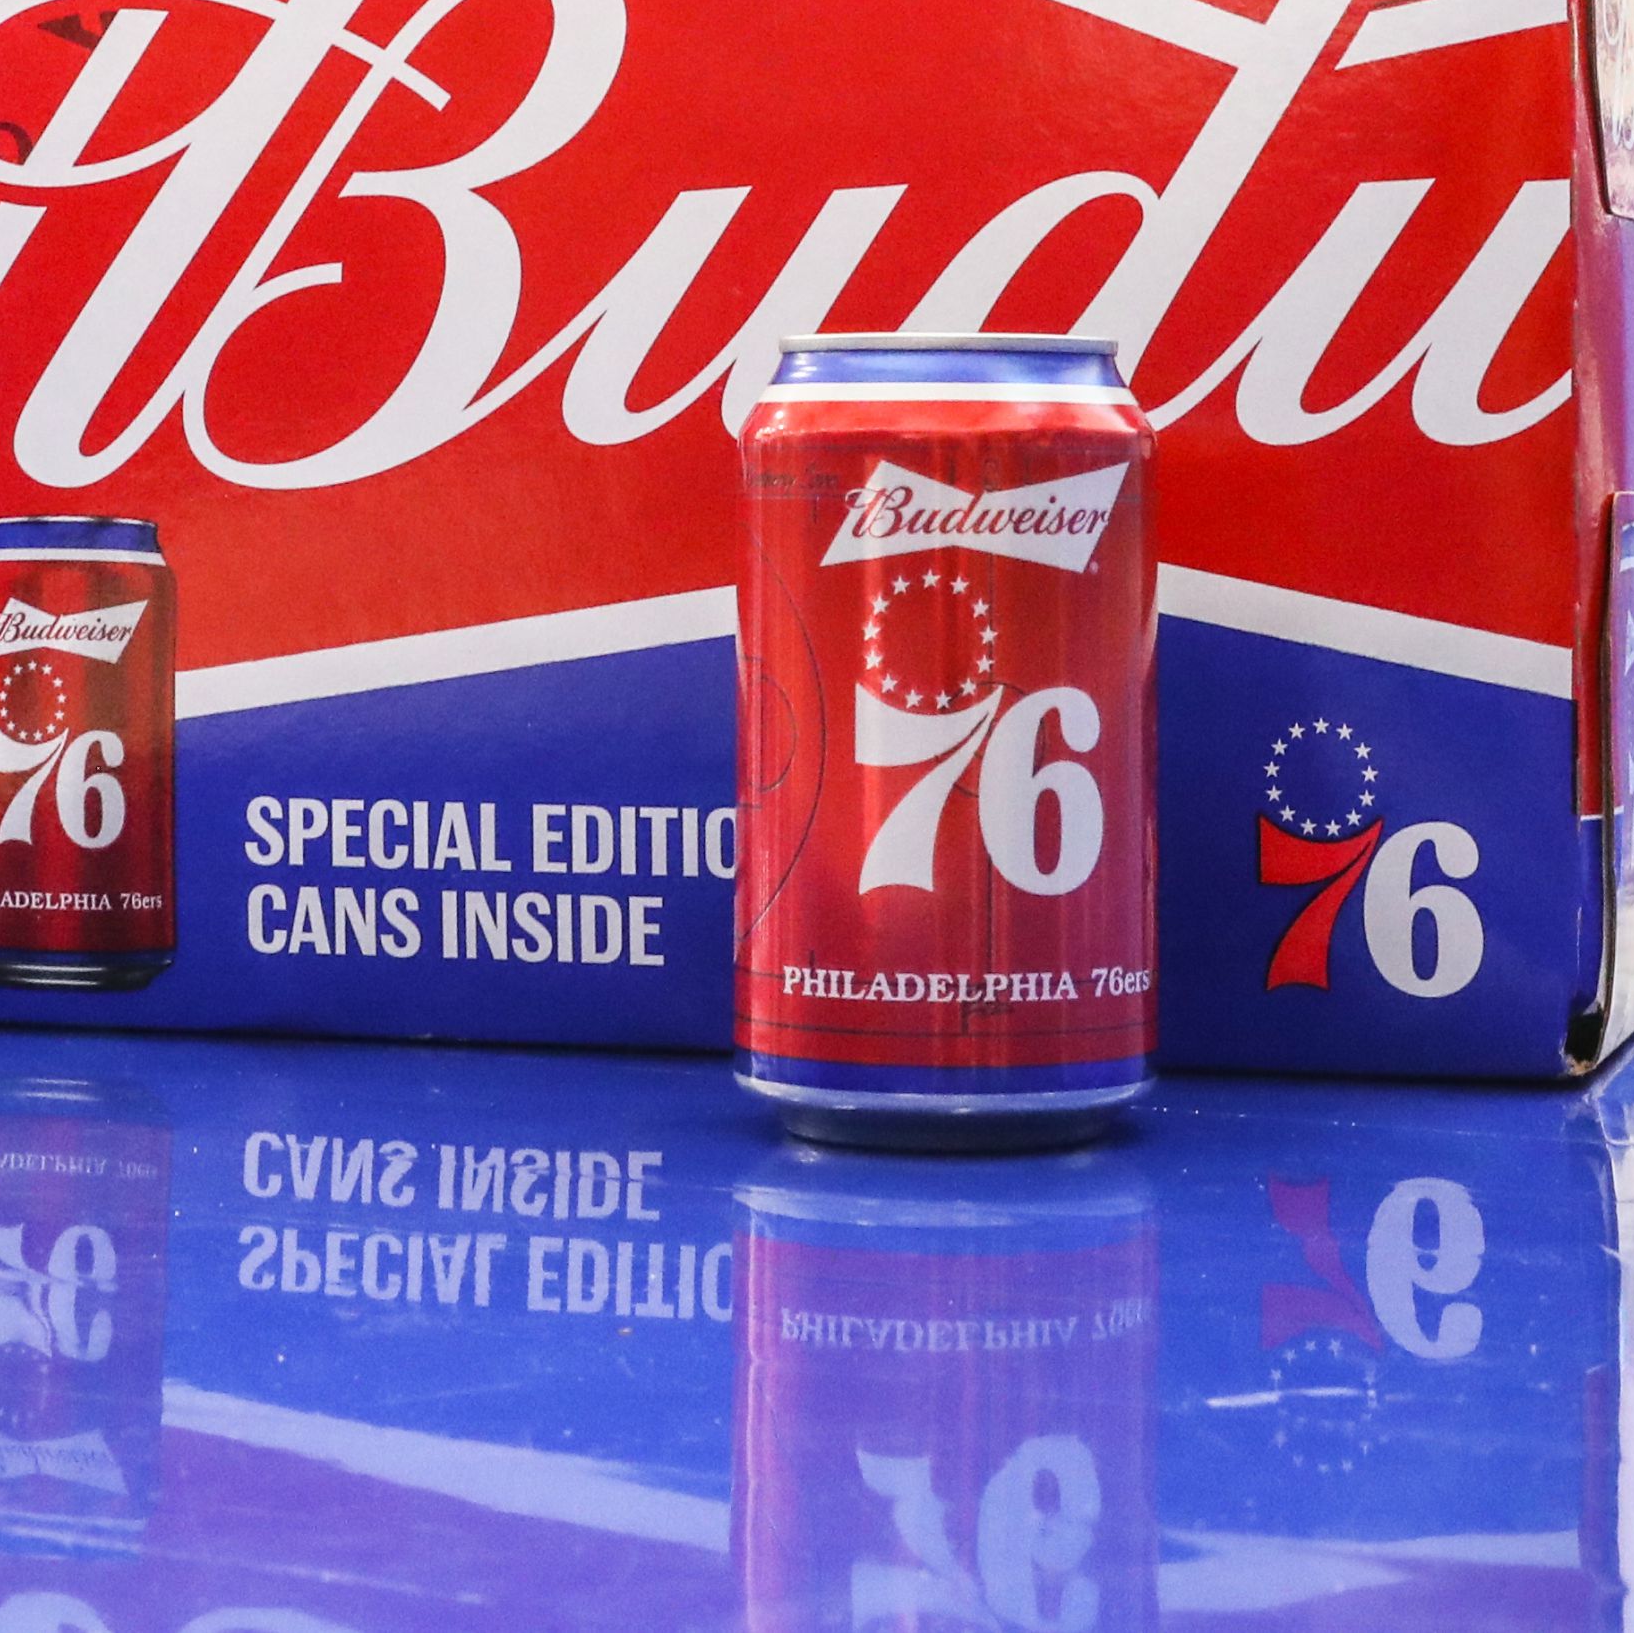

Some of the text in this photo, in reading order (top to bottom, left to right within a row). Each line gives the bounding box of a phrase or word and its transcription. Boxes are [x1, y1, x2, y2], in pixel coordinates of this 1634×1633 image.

[845, 484, 1113, 540] Budweiser
[855, 680, 1104, 896] 76
[244, 795, 737, 880] SPECIAL EDITIO
[121, 891, 163, 912] 76ers
[247, 883, 665, 967] CANS INSIDE
[1257, 814, 1485, 999] 76
[782, 965, 1152, 1004] PHILADELPHIA 76ers
